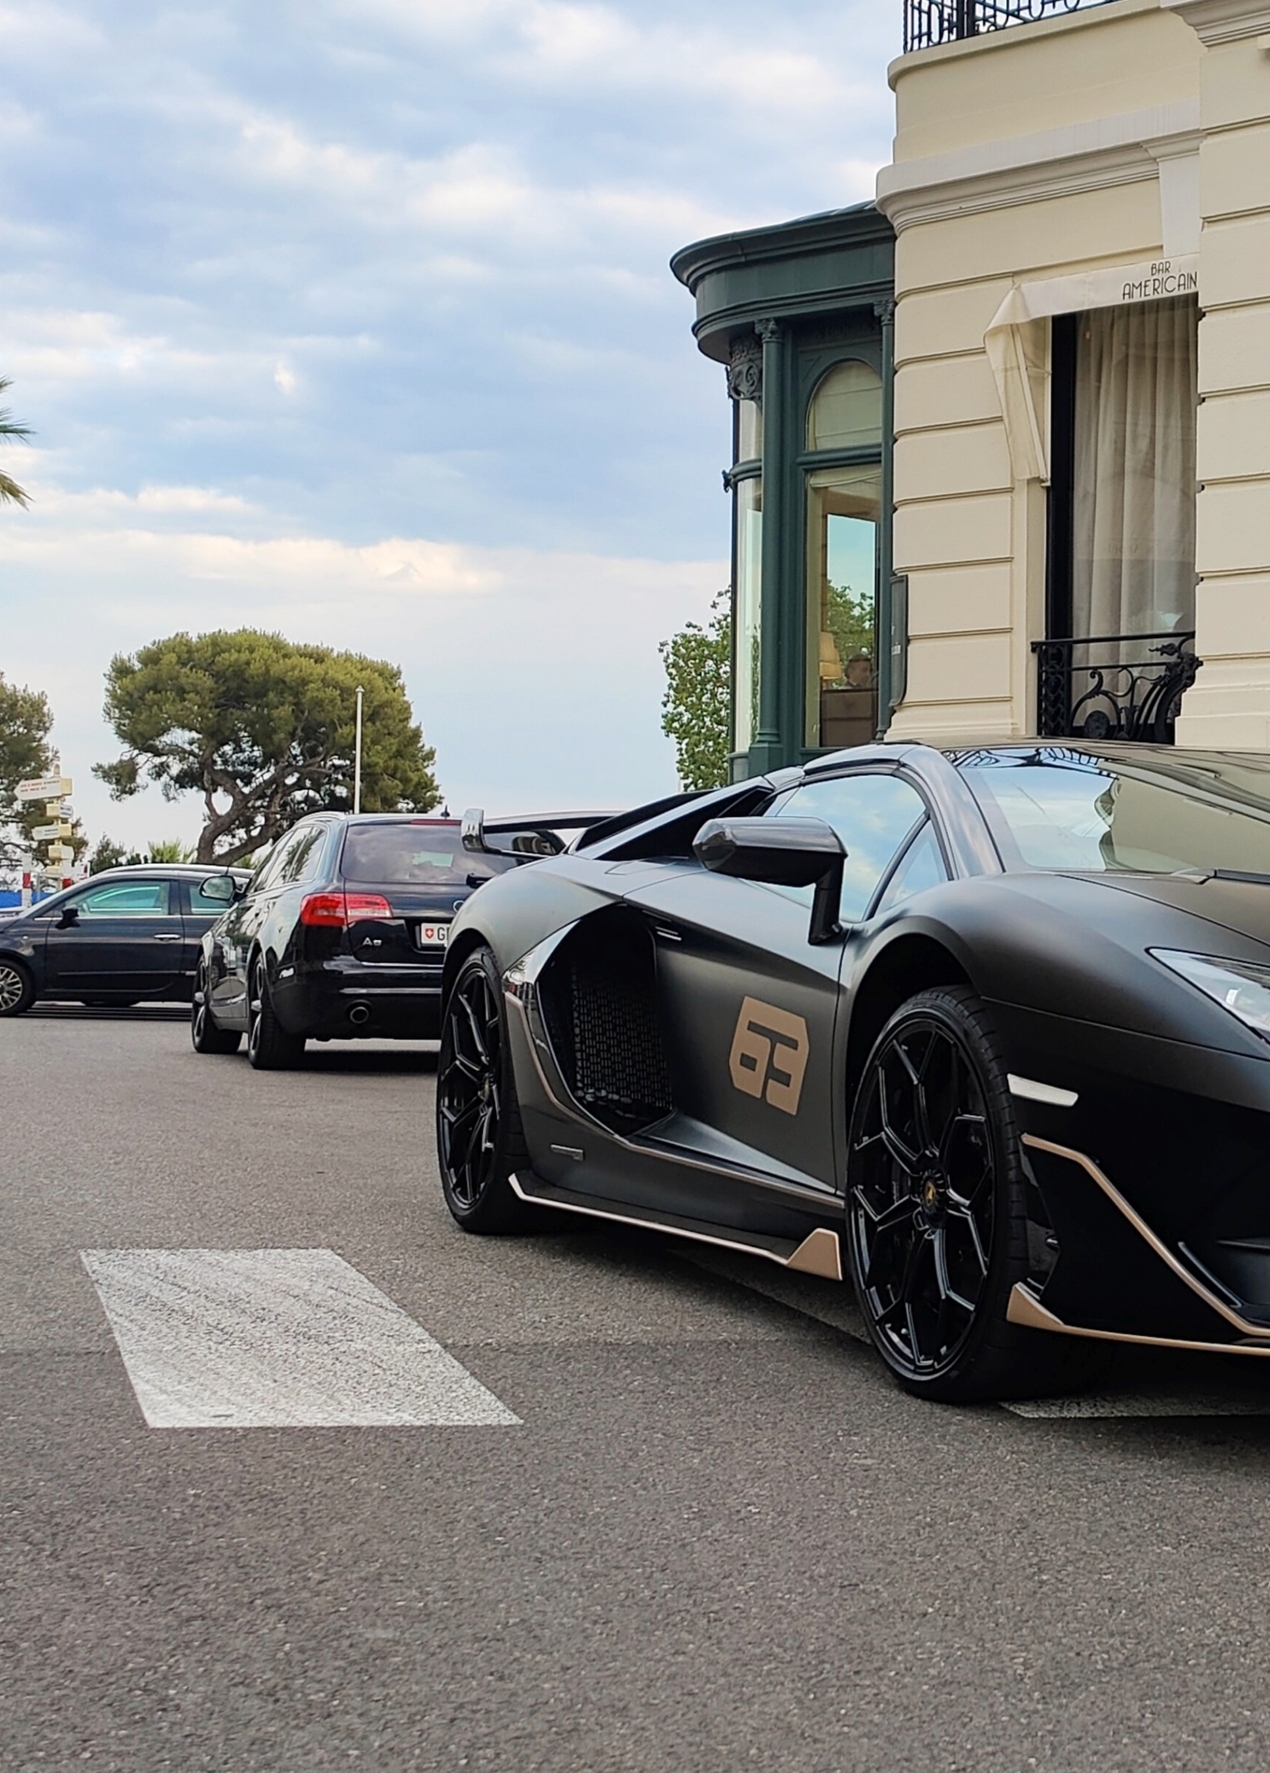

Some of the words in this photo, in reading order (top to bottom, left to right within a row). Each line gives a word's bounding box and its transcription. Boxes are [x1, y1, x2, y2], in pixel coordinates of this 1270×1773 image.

[1151, 260, 1171, 276] BAR
[1122, 271, 1197, 300] AMERICAIN
[728, 995, 810, 1116] 63
